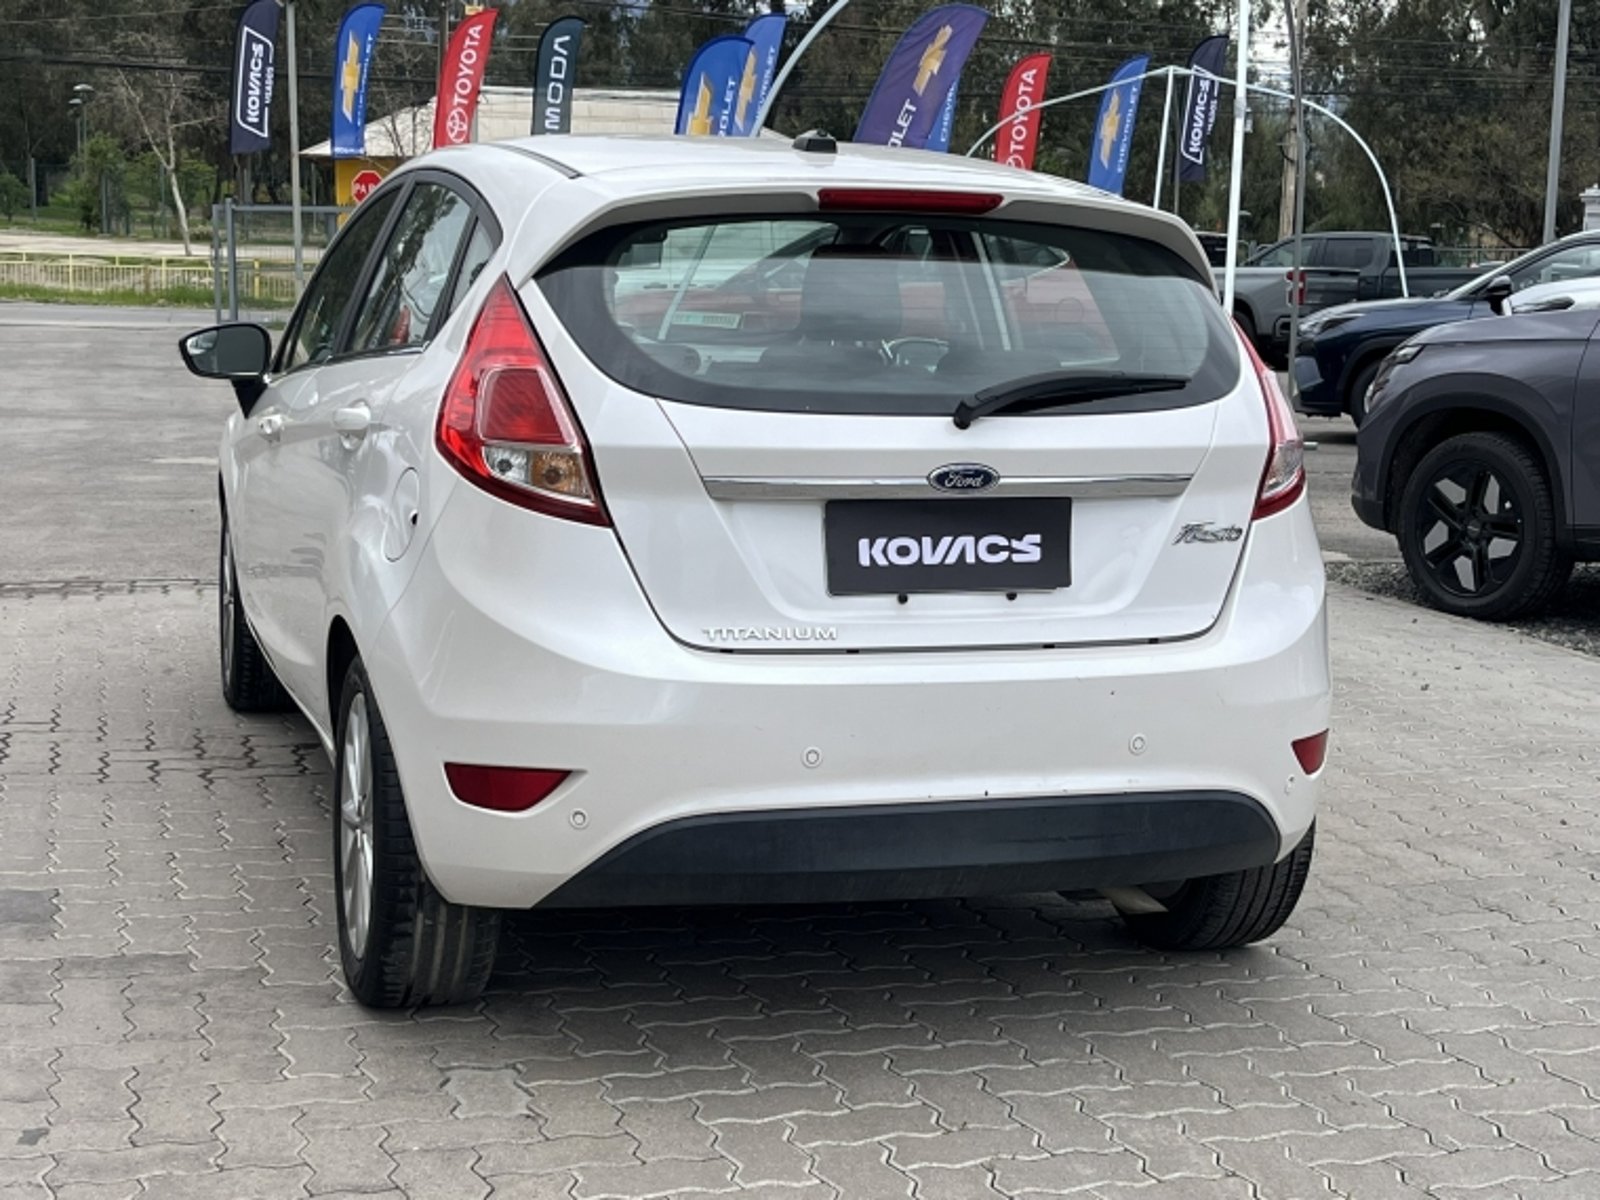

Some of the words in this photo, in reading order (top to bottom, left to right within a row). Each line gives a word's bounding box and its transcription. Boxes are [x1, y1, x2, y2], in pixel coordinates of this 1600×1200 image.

[247, 42, 264, 123] KOVACS
[453, 24, 484, 106] TOYOTA
[545, 35, 571, 130] MODA
[888, 98, 917, 148] OLET
[940, 81, 957, 142] CHEVR
[1010, 68, 1038, 153] TOYOTA
[1189, 79, 1210, 152] KOVACS
[944, 471, 984, 487] Ford
[858, 534, 1042, 567] KOVACS
[702, 626, 838, 641] TITANIUM
